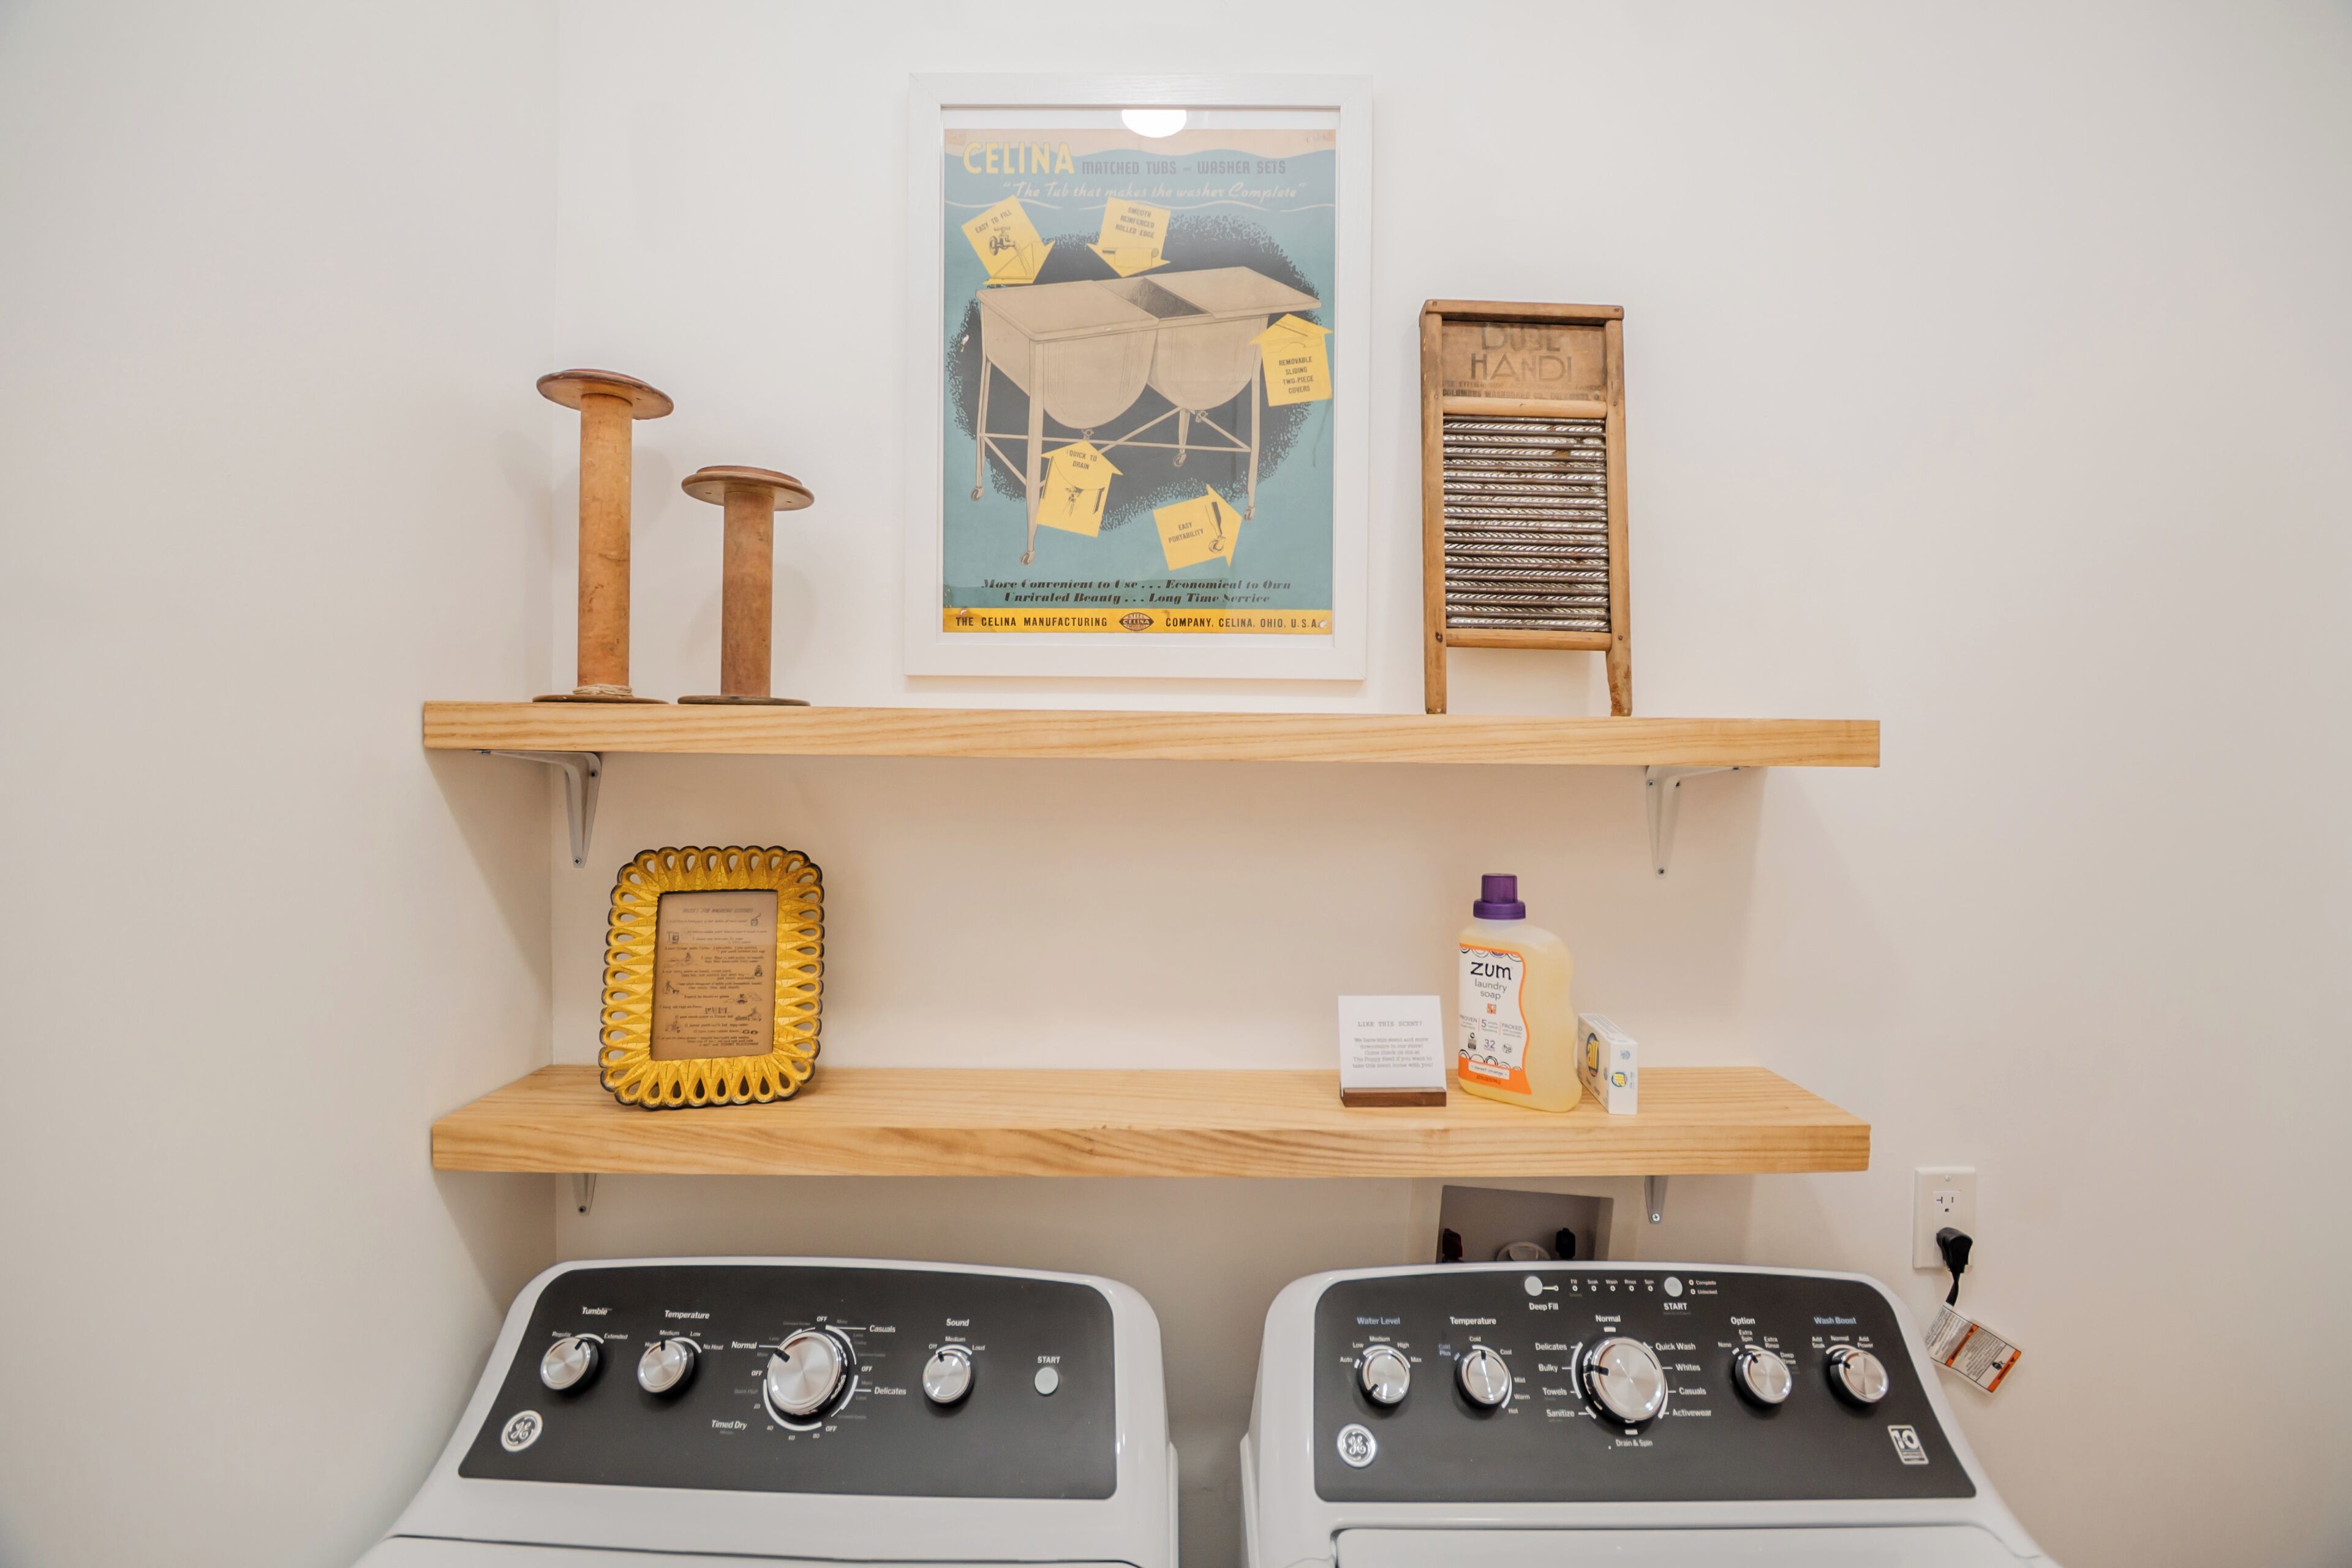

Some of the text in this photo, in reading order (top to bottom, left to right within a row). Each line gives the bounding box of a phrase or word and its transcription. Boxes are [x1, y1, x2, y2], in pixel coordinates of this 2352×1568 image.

[963, 141, 1074, 174] CELINA
[1082, 161, 1139, 175] MATCHED
[1146, 161, 1177, 175] TUBS
[1197, 161, 1250, 174] WASHER
[1257, 160, 1286, 174] SETS
[1044, 181, 1068, 197] Tub
[1073, 183, 1101, 197] that
[1104, 183, 1147, 197] makes
[1152, 183, 1172, 197] the
[1177, 183, 1224, 197] washer
[1128, 206, 1152, 217] SMOOTH
[974, 222, 989, 234] EASY
[1000, 209, 1012, 220] FILL
[1120, 215, 1155, 228] REINFORCED
[1115, 224, 1155, 239] ROLLED EDGE
[1279, 356, 1313, 366] REMOVABLE
[1285, 366, 1308, 375] SLIDING
[1471, 353, 1572, 382] HANDI
[1288, 385, 1310, 394] COVERS
[1069, 450, 1087, 459] QUICK
[1072, 461, 1090, 470] DRAIN
[1178, 521, 1192, 530] EASY
[1168, 529, 1204, 544] PORTABILITY
[981, 579, 1017, 589] More
[1021, 579, 1093, 589] Convenient
[1098, 579, 1110, 589] to
[1166, 579, 1242, 589] Economical
[1263, 580, 1291, 589] Own
[1004, 592, 1070, 602] Unrivaled
[1148, 593, 1182, 605] Long
[1186, 593, 1219, 602] Time
[1223, 594, 1270, 603] Service
[956, 617, 1107, 626] THE CELINA MANUFACTURING
[1166, 617, 1213, 628] COMPANY,
[1475, 978, 1507, 993] laundry
[1480, 990, 1501, 1001] soap
[1481, 1019, 1487, 1028] 5
[1484, 1039, 1495, 1049] 32
[582, 1306, 608, 1315] Tumble
[665, 1310, 710, 1319] Temperature
[1450, 1316, 1496, 1325] Temperature
[1731, 1317, 1755, 1325] Option
[869, 1325, 896, 1333] Casuals
[874, 1387, 907, 1395] Delicates
[734, 1420, 747, 1430] Dry
[1891, 1429, 1919, 1449] 10
